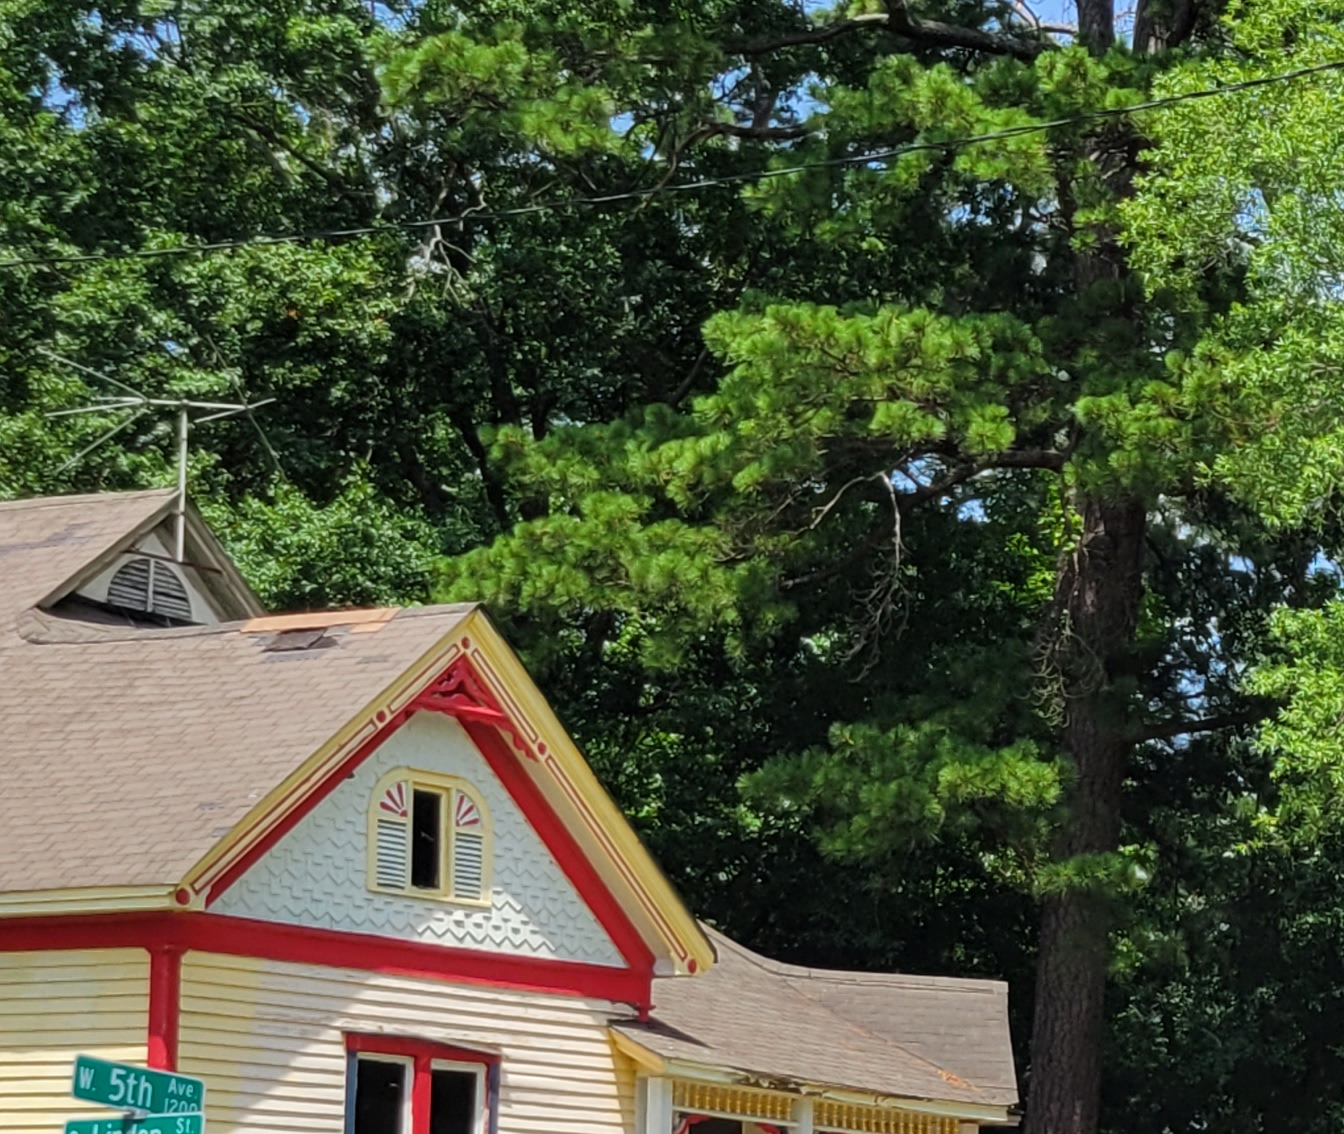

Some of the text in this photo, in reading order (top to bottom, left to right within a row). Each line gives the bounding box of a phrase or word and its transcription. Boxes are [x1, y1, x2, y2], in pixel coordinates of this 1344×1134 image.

[79, 1066, 198, 1108] W. 5th Ave.
